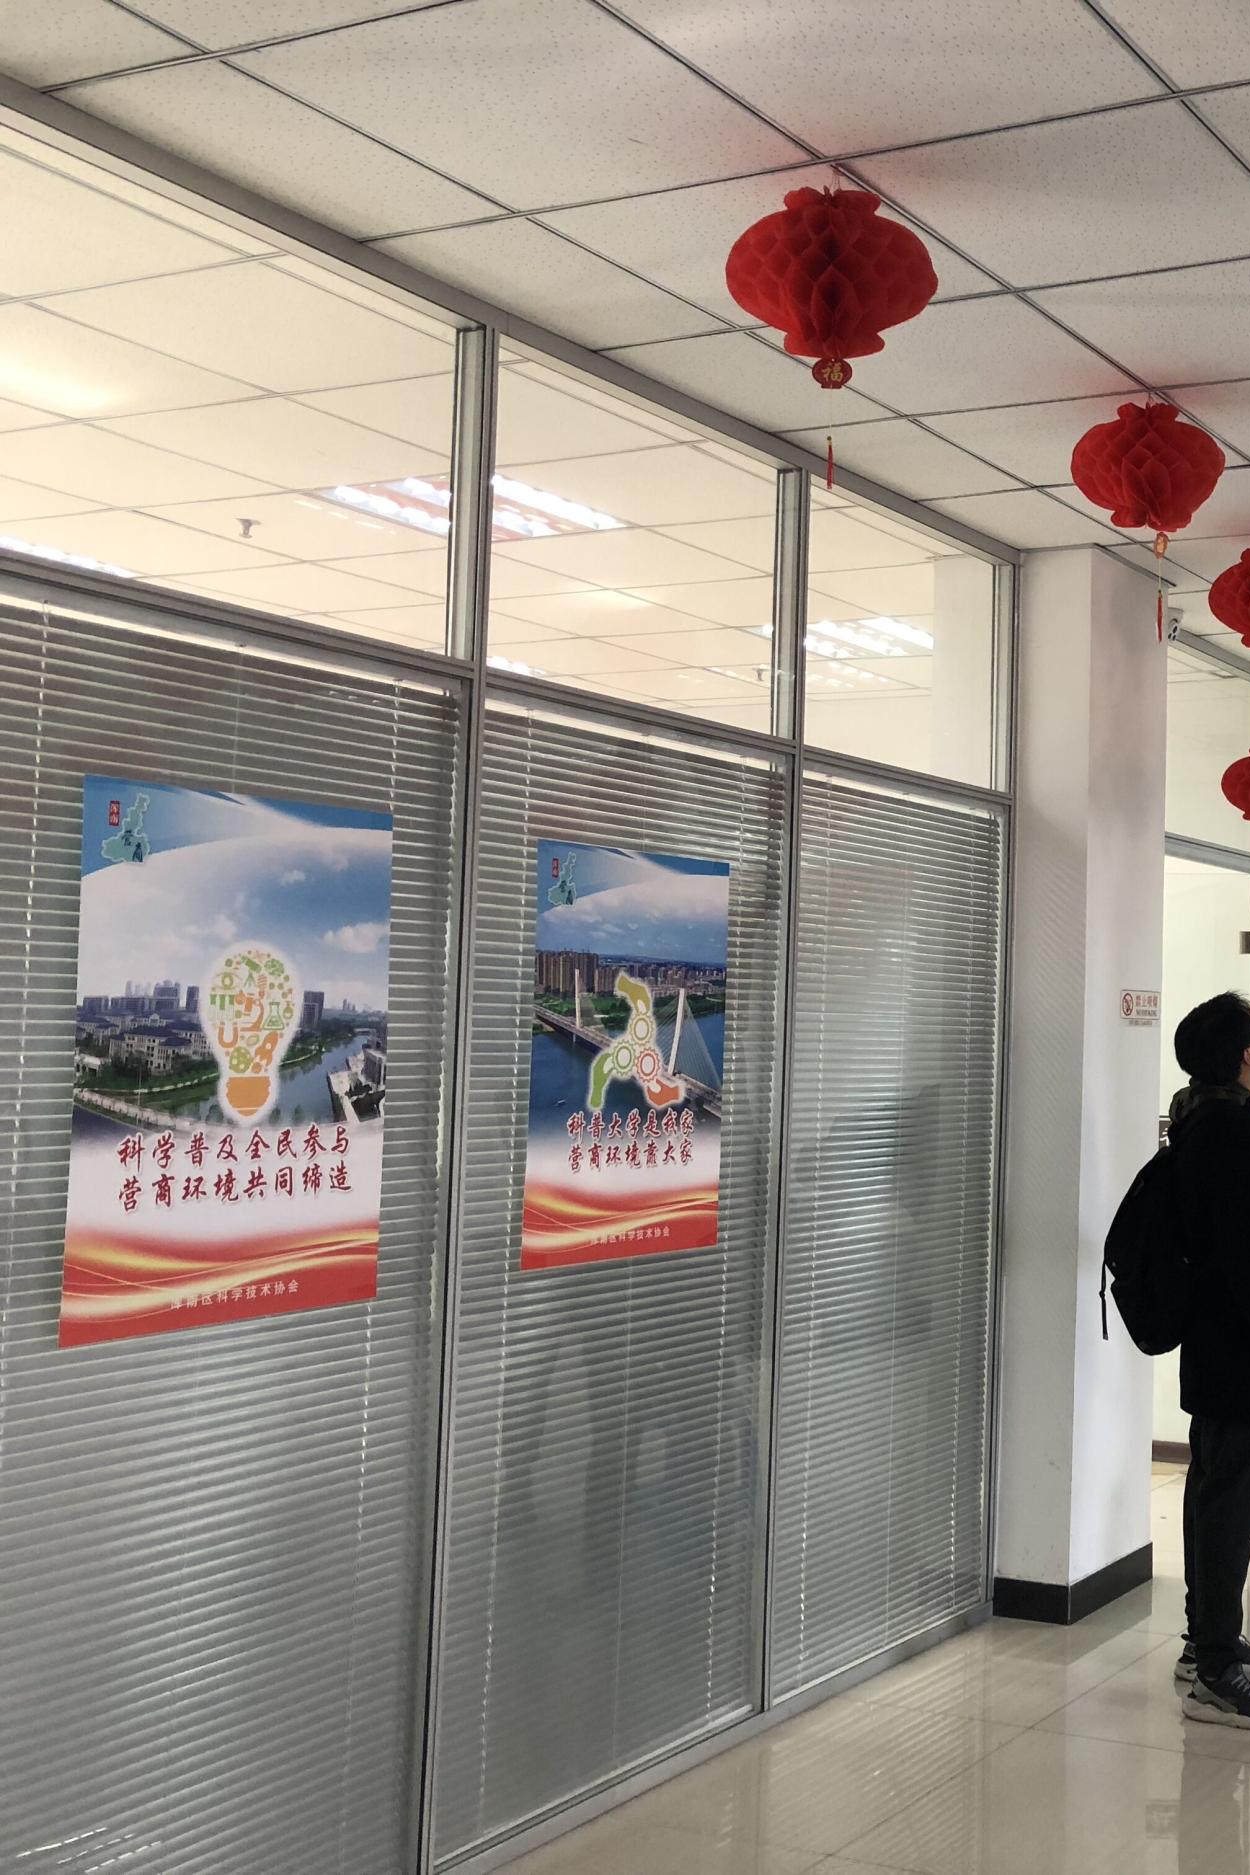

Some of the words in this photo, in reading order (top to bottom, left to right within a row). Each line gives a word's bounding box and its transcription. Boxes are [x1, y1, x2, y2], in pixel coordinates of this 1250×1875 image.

[822, 361, 844, 382] 福
[567, 1108, 694, 1142] 科普大学是我家
[117, 1124, 350, 1172] 科学普及全民参与
[568, 1139, 693, 1173] 营商环境靠大家
[118, 1161, 352, 1212] 营商环境共同缔造
